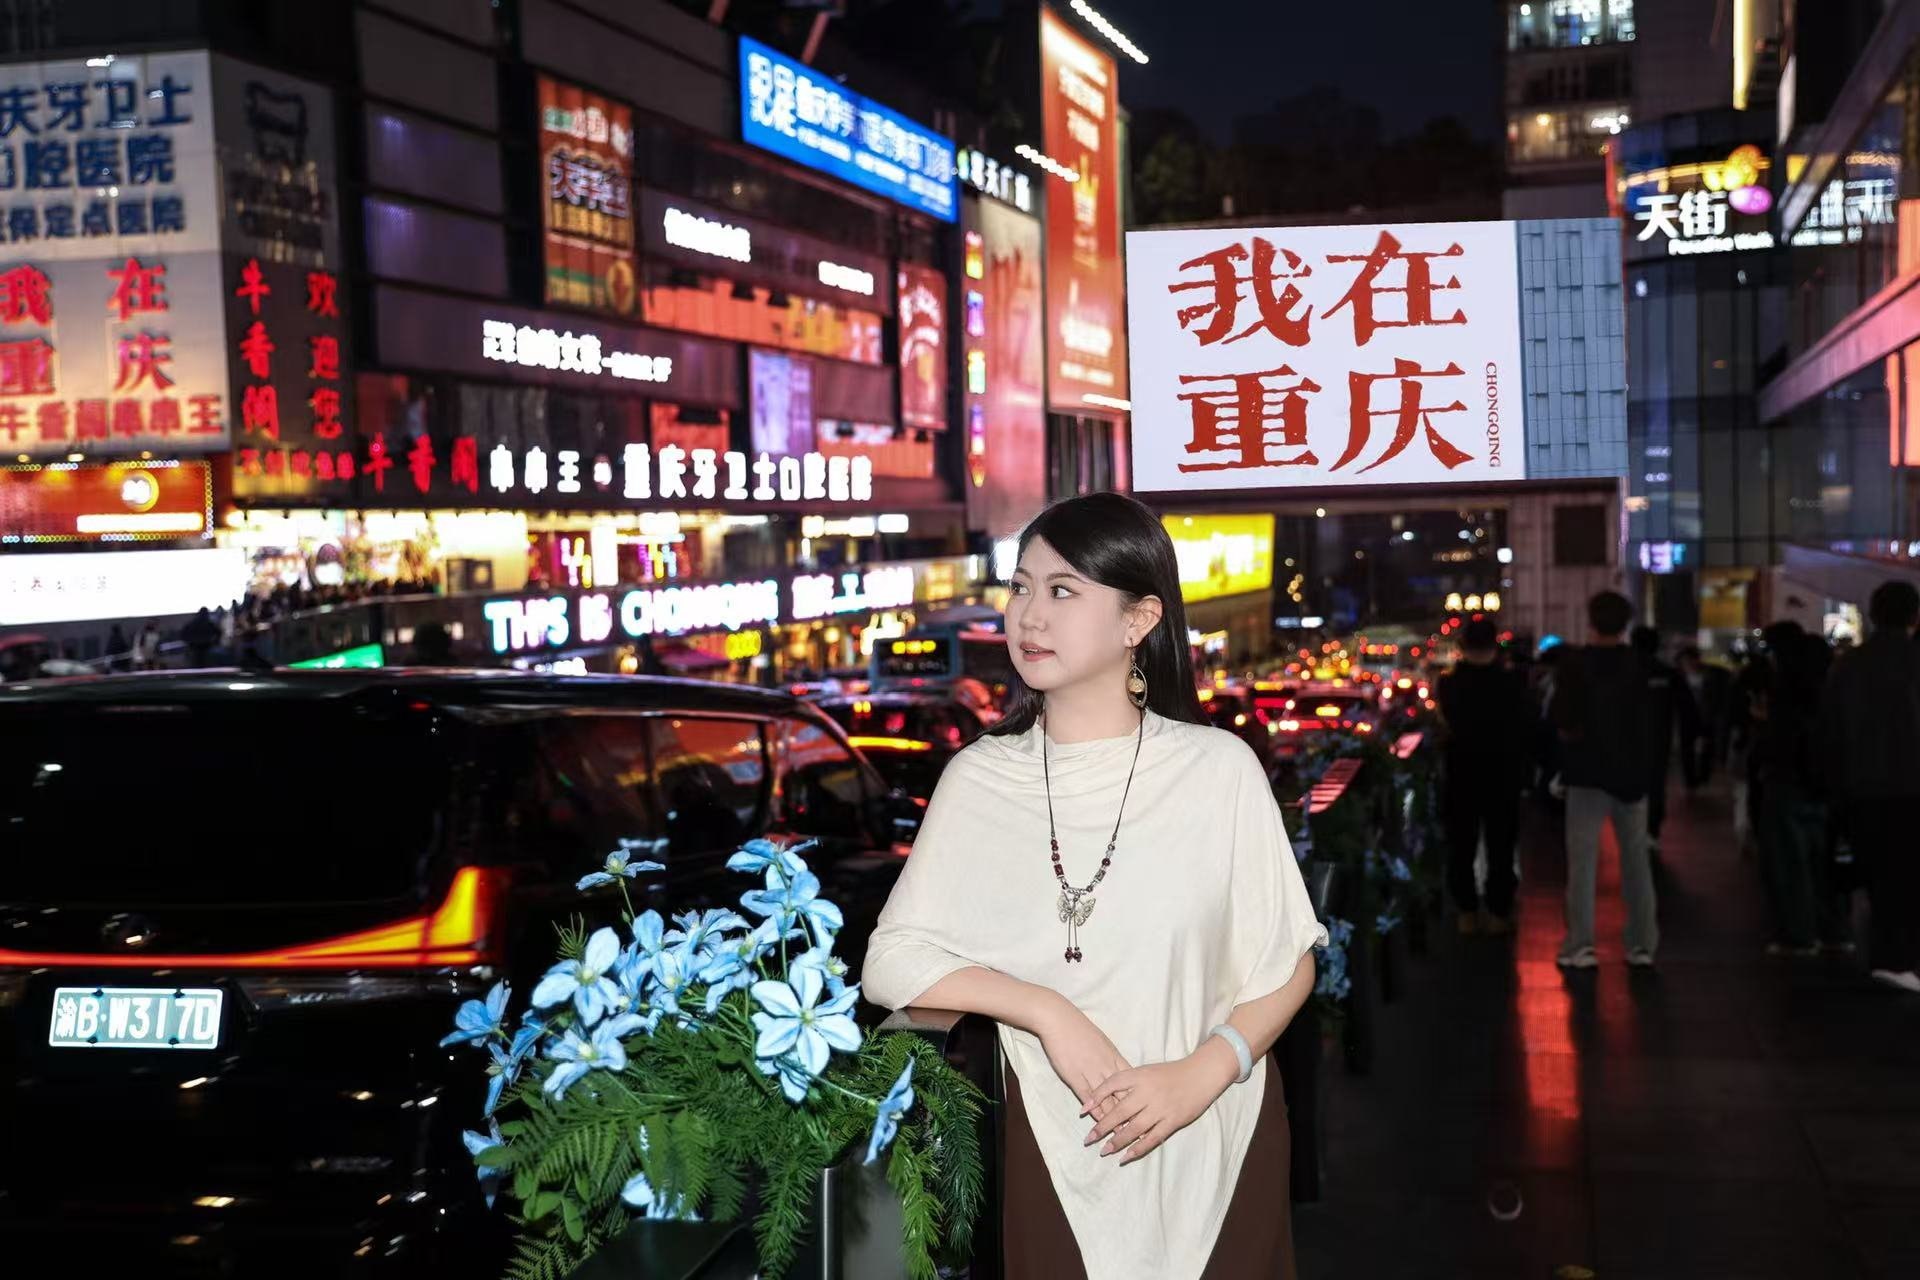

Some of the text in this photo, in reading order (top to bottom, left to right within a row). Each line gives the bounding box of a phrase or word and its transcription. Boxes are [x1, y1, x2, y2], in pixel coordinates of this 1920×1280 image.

[1634, 187, 1729, 241] 天街
[1168, 230, 1468, 347] 我在
[1177, 357, 1475, 475] 重庆
[1486, 362, 1501, 467] CHONGQING
[484, 596, 569, 652] THIS
[579, 594, 613, 641] IS
